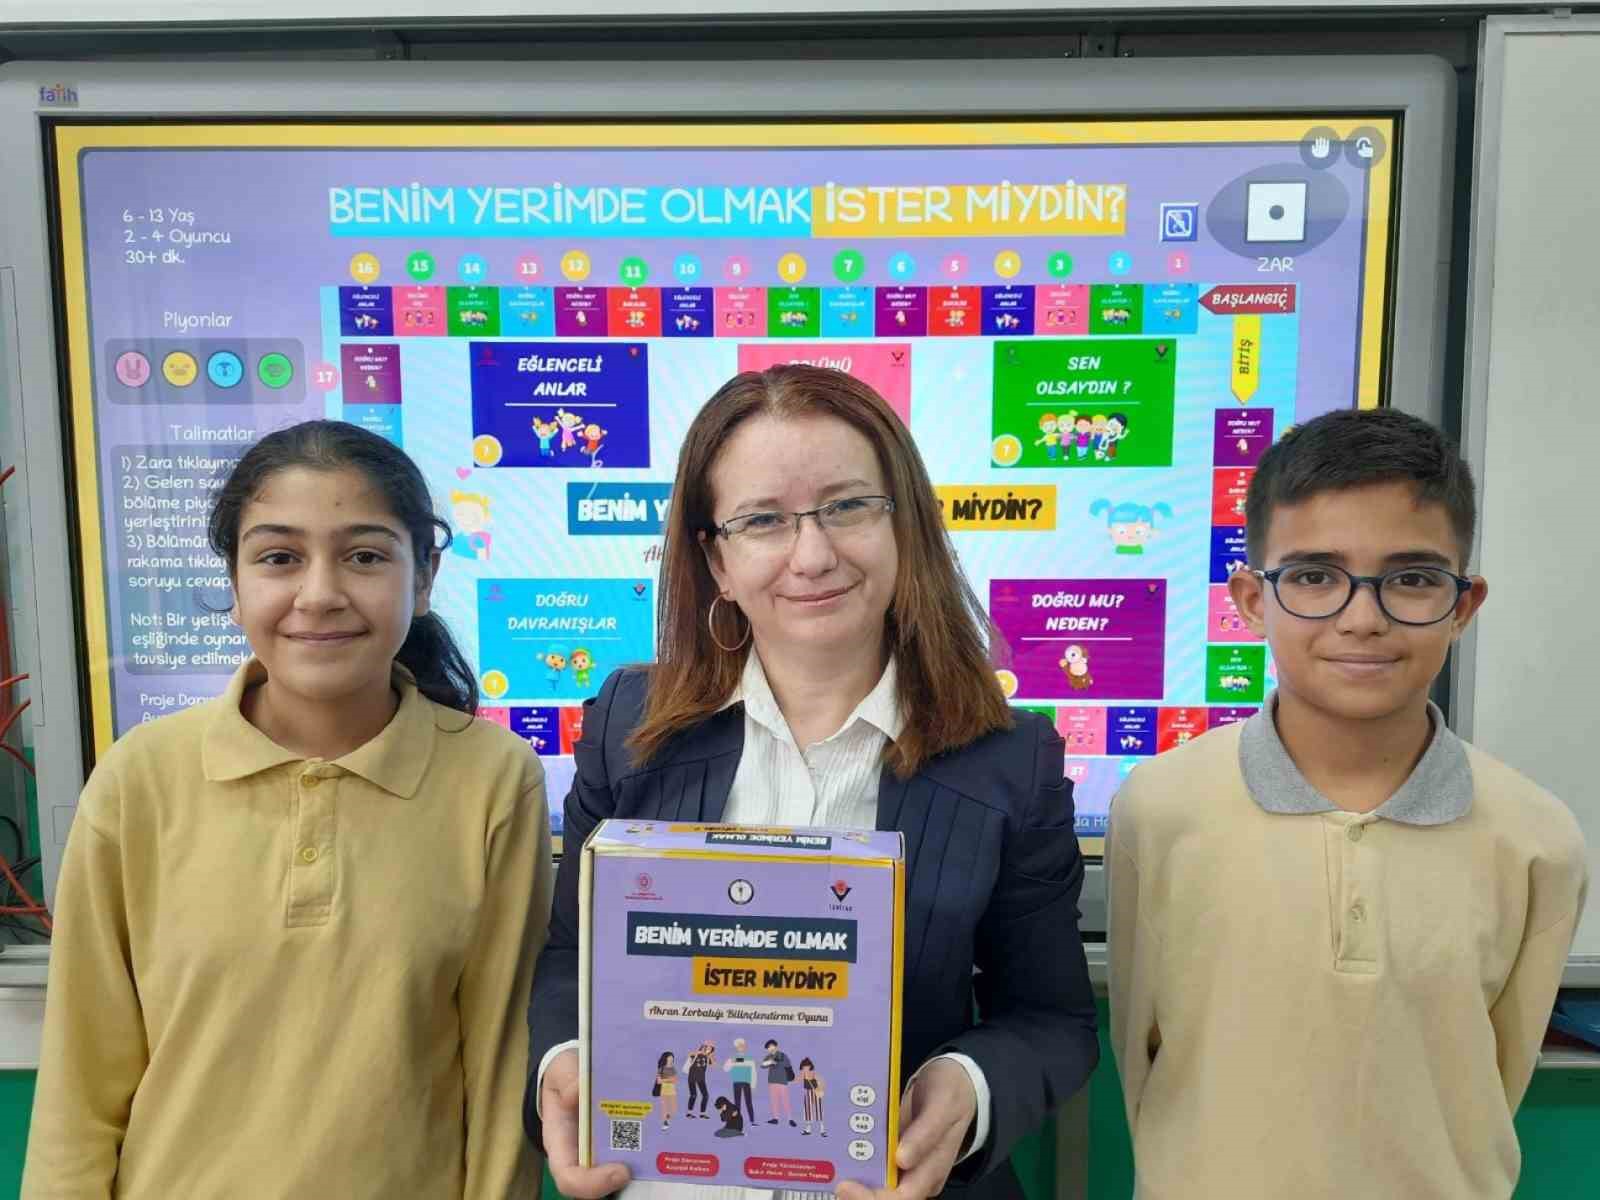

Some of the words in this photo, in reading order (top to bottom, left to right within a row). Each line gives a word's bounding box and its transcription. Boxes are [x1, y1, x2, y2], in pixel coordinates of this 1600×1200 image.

[329, 182, 454, 225] BENİM
[467, 182, 647, 225] YERİMDE
[660, 186, 811, 225] OLMAK
[825, 182, 952, 224] İSTER
[967, 180, 1126, 224] MİYDİN?
[123, 208, 134, 222] 6
[149, 208, 164, 223] 13
[168, 208, 195, 226] Yaş
[123, 229, 136, 243] 2
[152, 229, 164, 242] 4
[169, 228, 232, 248] Oyuncu
[126, 249, 157, 264] 30+
[162, 248, 185, 264] dk.
[413, 258, 429, 272] 15
[464, 262, 480, 274] 14
[520, 262, 538, 275] 13
[567, 259, 584, 272] 12
[679, 262, 696, 275] 10
[1257, 257, 1294, 271] ZAR
[625, 266, 642, 279] 11
[164, 309, 232, 332] Piyonlar
[517, 354, 603, 373] EĞLENCELİ
[1067, 356, 1102, 371] SEN
[317, 370, 333, 382] 17
[533, 381, 587, 396] ANLAR
[1036, 380, 1117, 395] OLSAYDIN
[170, 423, 256, 441] Talimatlar
[136, 455, 173, 469] Zara
[122, 475, 140, 490] 2)
[144, 475, 194, 489] Gelen
[124, 496, 180, 509] bölüme
[578, 492, 648, 522] BENİM
[952, 492, 1043, 521] MİYDİN?
[124, 514, 210, 532] yerleştirini
[127, 534, 142, 549] 3)
[128, 556, 184, 568] rakama
[188, 554, 228, 574] tıklay
[128, 576, 182, 591] soruyu
[186, 576, 231, 591] cevap
[535, 591, 590, 607] DOĞRU
[1031, 591, 1084, 608] DOĞRU
[1089, 593, 1125, 608] MU?
[130, 613, 162, 626] Not:
[167, 612, 186, 626] Bir
[507, 616, 618, 633] DAVRANIŞLAR
[1046, 616, 1108, 631] NEDEN?
[132, 630, 199, 648] eşliğinde
[135, 652, 187, 669] tavsiye
[192, 651, 249, 665] edilmek
[140, 693, 176, 711] Proje
[635, 921, 692, 946] BENİM
[698, 924, 778, 949] YERİMDE
[784, 930, 848, 951] OLMAK
[704, 963, 756, 987] İSTER
[763, 965, 838, 990] MİYDİN?
[649, 1005, 679, 1017] Akran
